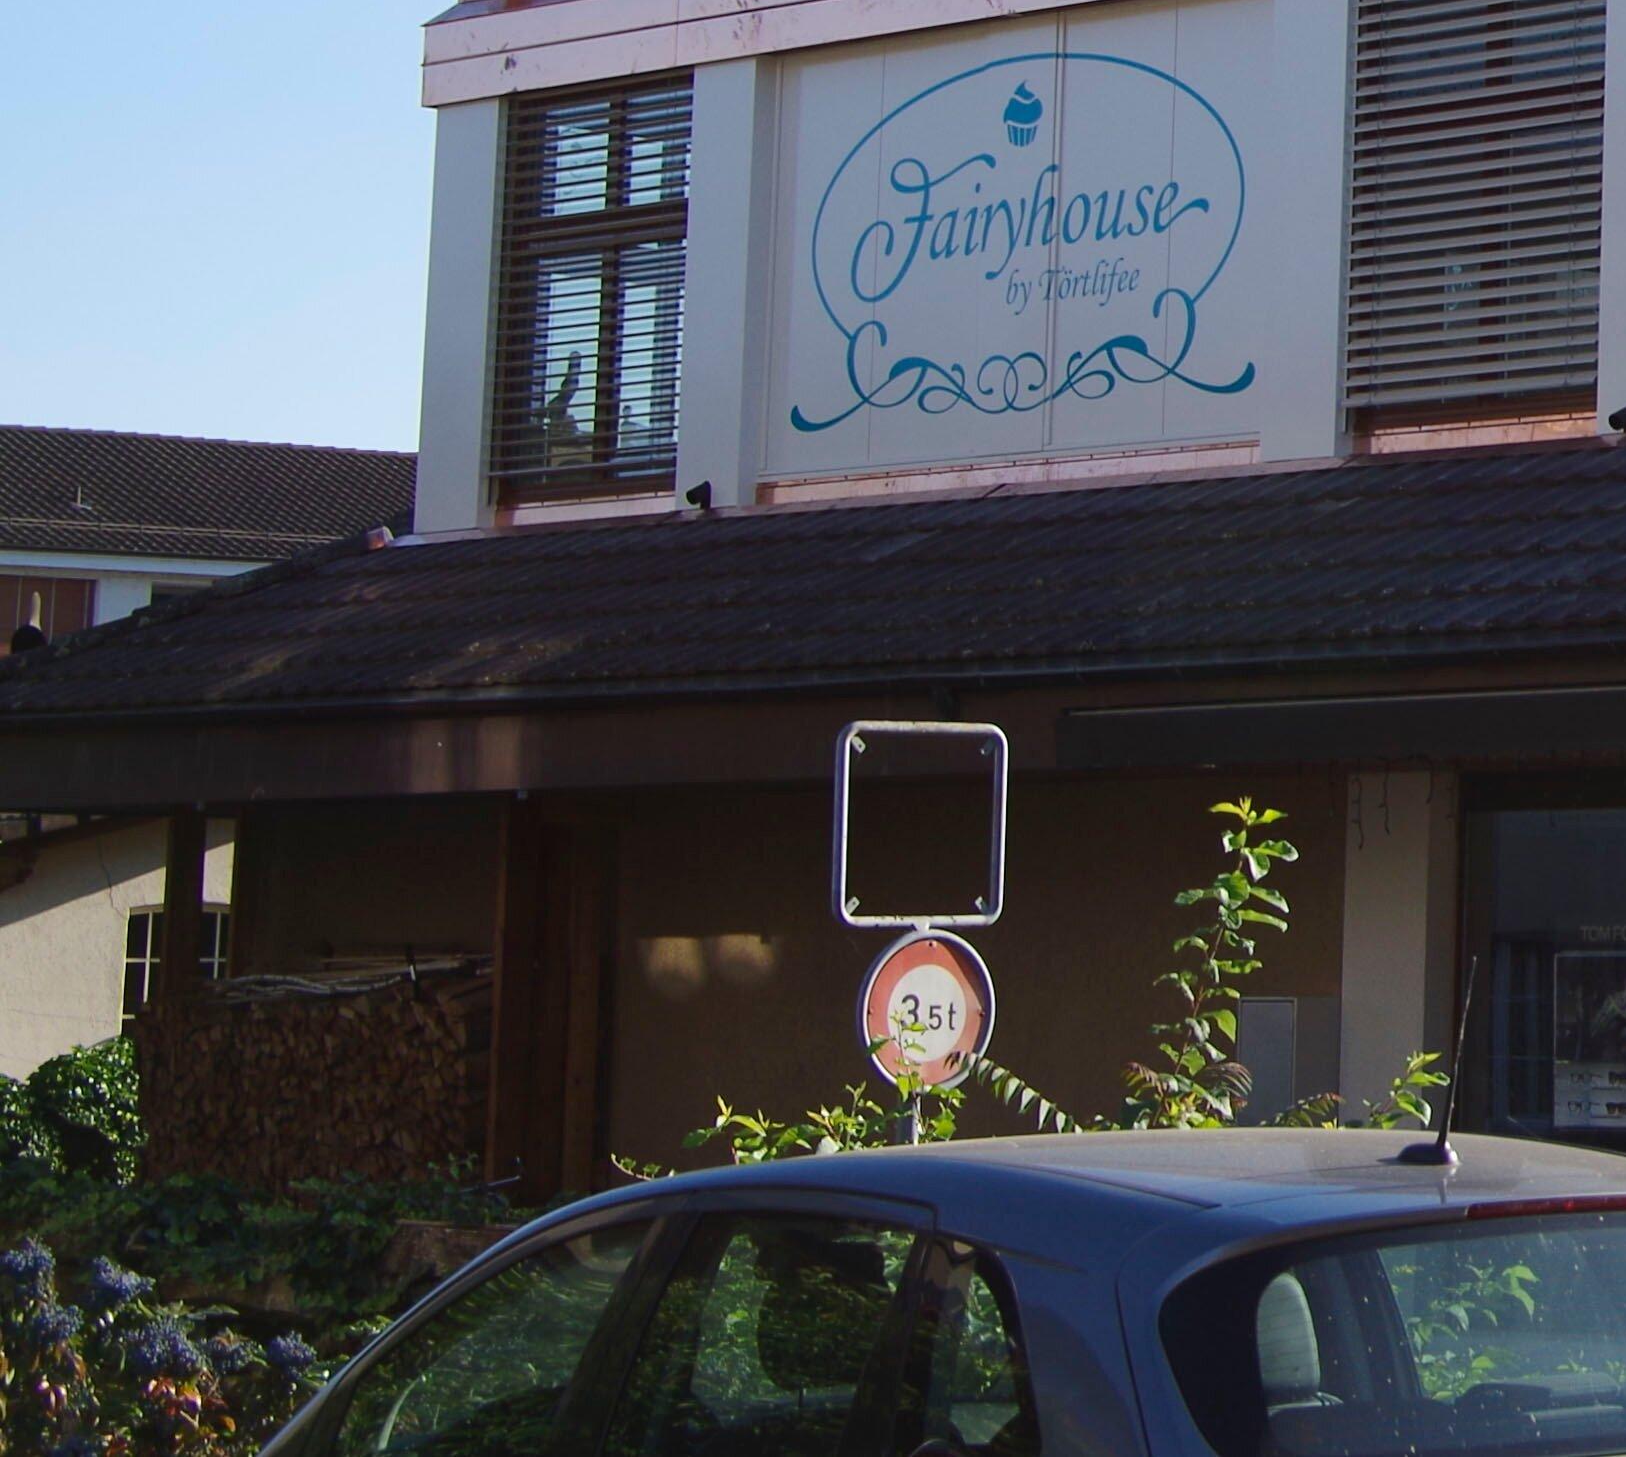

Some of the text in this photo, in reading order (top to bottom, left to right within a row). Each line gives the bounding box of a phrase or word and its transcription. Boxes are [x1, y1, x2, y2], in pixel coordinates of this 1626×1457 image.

[851, 153, 1210, 302] Fairyhouse
[1006, 257, 1140, 315] by Törtlifee
